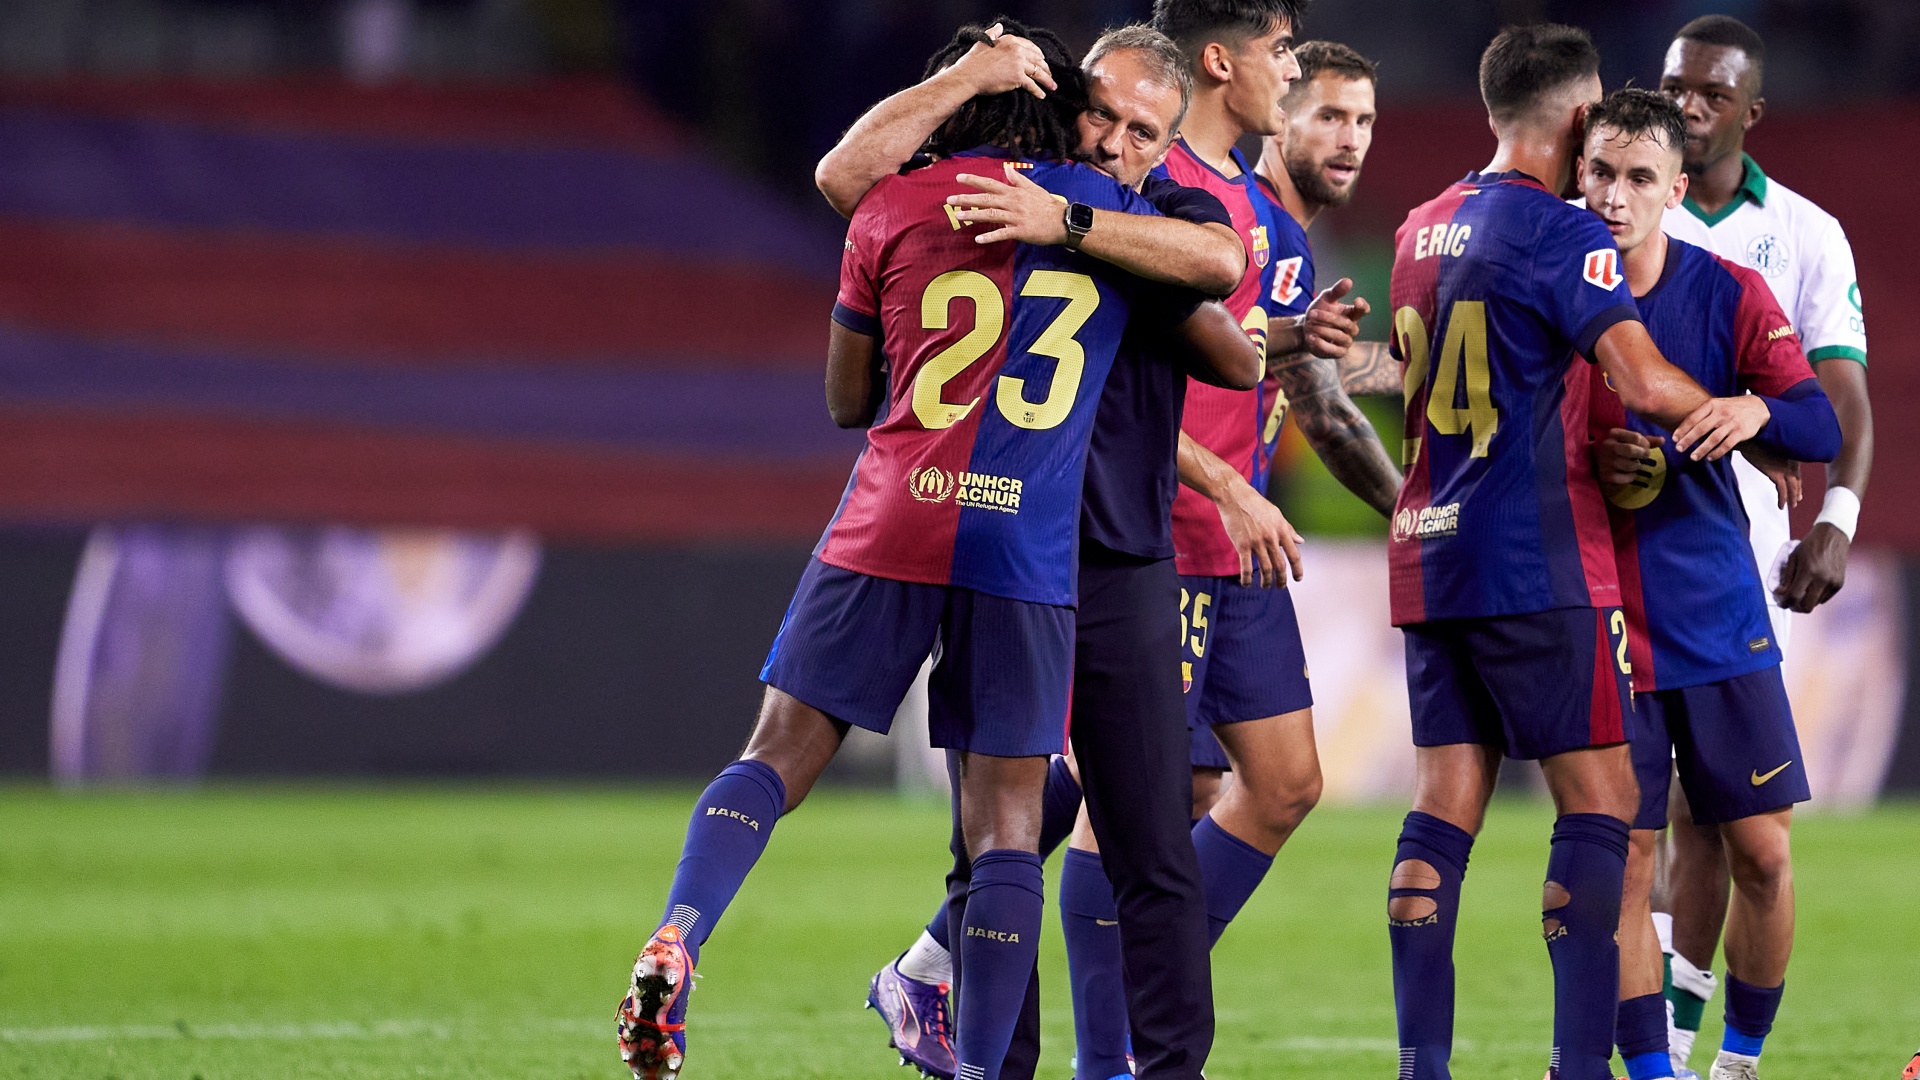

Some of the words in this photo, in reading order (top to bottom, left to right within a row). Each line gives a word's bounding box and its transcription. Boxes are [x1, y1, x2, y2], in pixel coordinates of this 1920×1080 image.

[1415, 223, 1472, 261] ERIC
[911, 270, 1100, 430] 23
[1395, 301, 1499, 465] 24
[958, 471, 1023, 494] UNHCR
[955, 485, 1021, 508] ACNUR
[975, 502, 998, 511] Refugee
[998, 505, 1019, 515] Agency
[1418, 502, 1460, 521] UNHCR
[1415, 516, 1458, 534] ACNUR
[706, 807, 759, 831] BARÇA
[966, 926, 1020, 943] BARÇA
